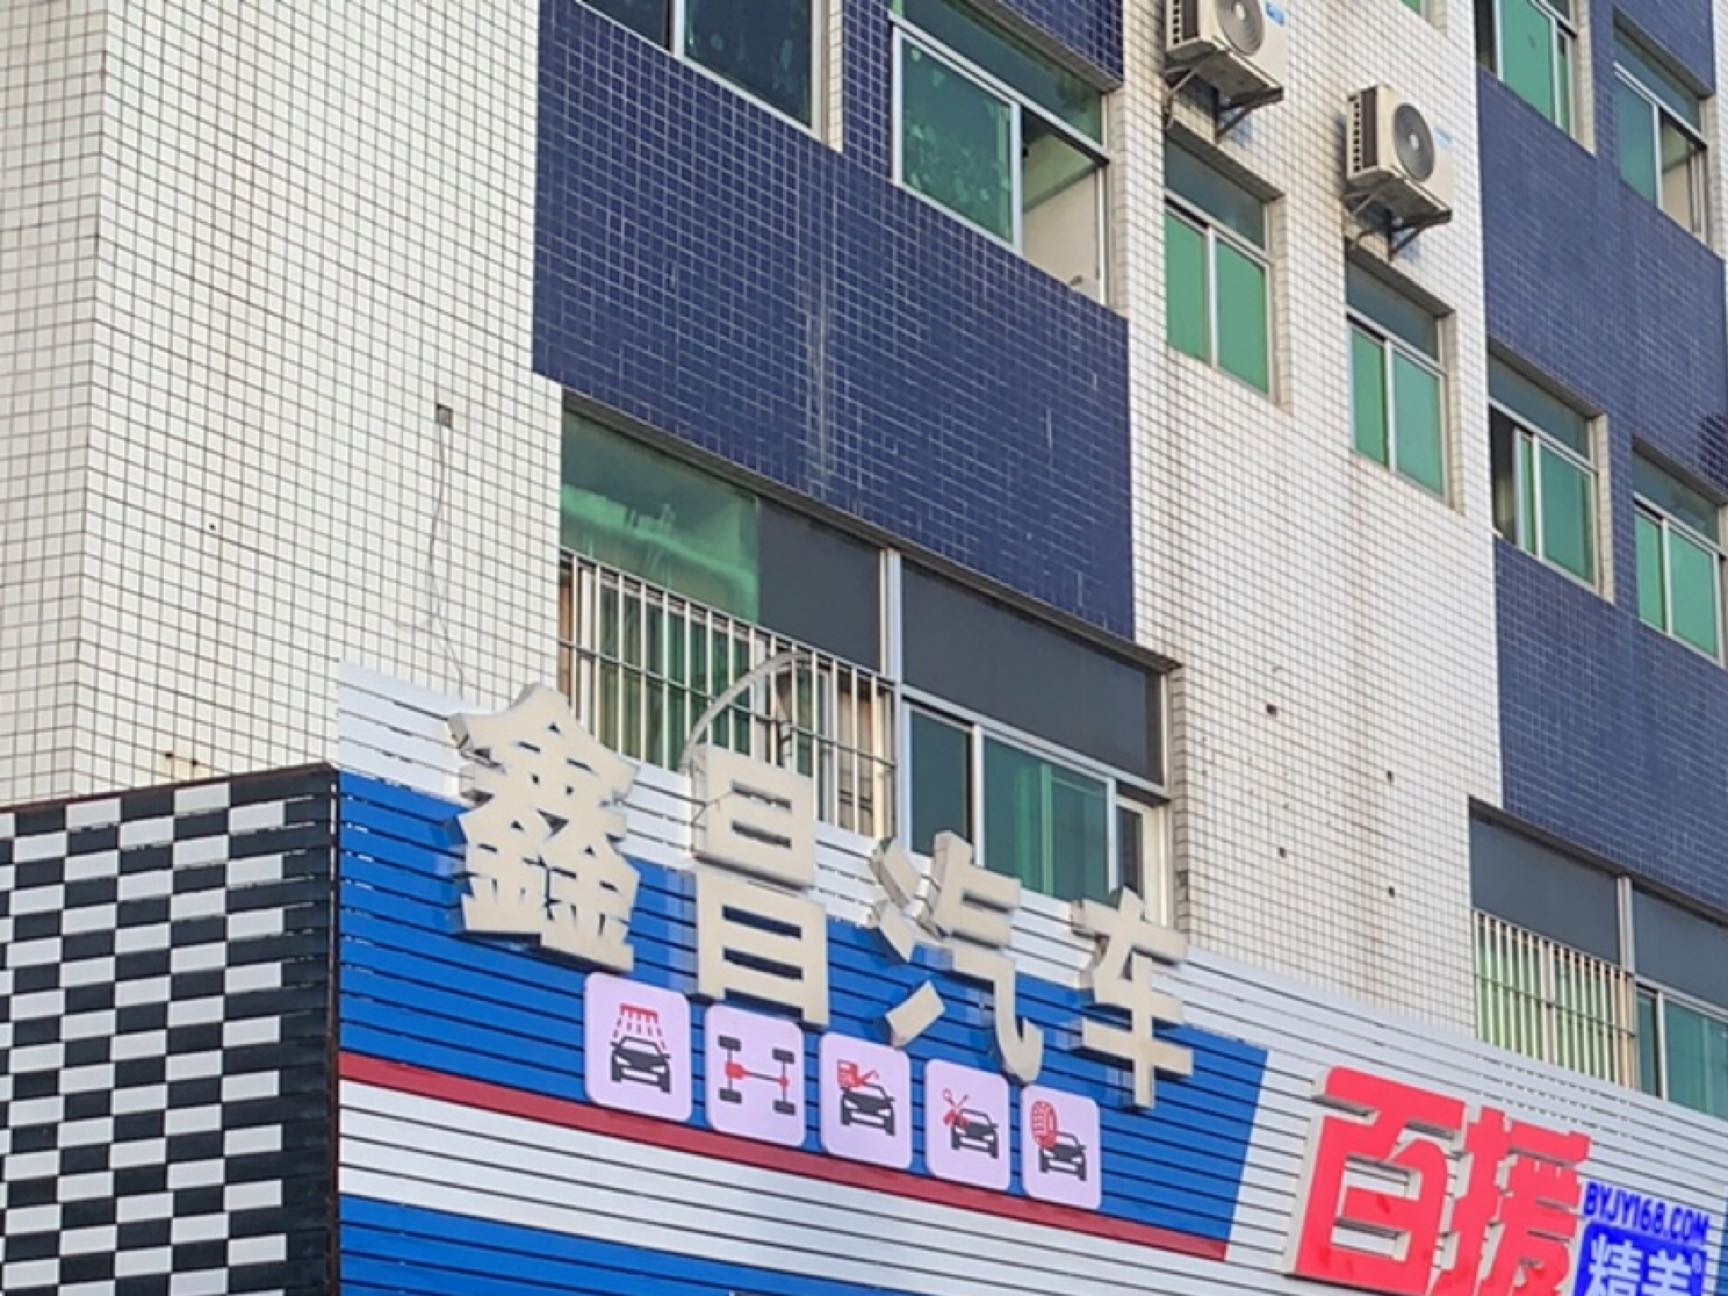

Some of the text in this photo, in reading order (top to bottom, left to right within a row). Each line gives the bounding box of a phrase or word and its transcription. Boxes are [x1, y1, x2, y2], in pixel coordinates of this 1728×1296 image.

[448, 683, 1193, 1109] 鑫昌汽车
[1583, 1182, 1711, 1245] BYJY168.COM
